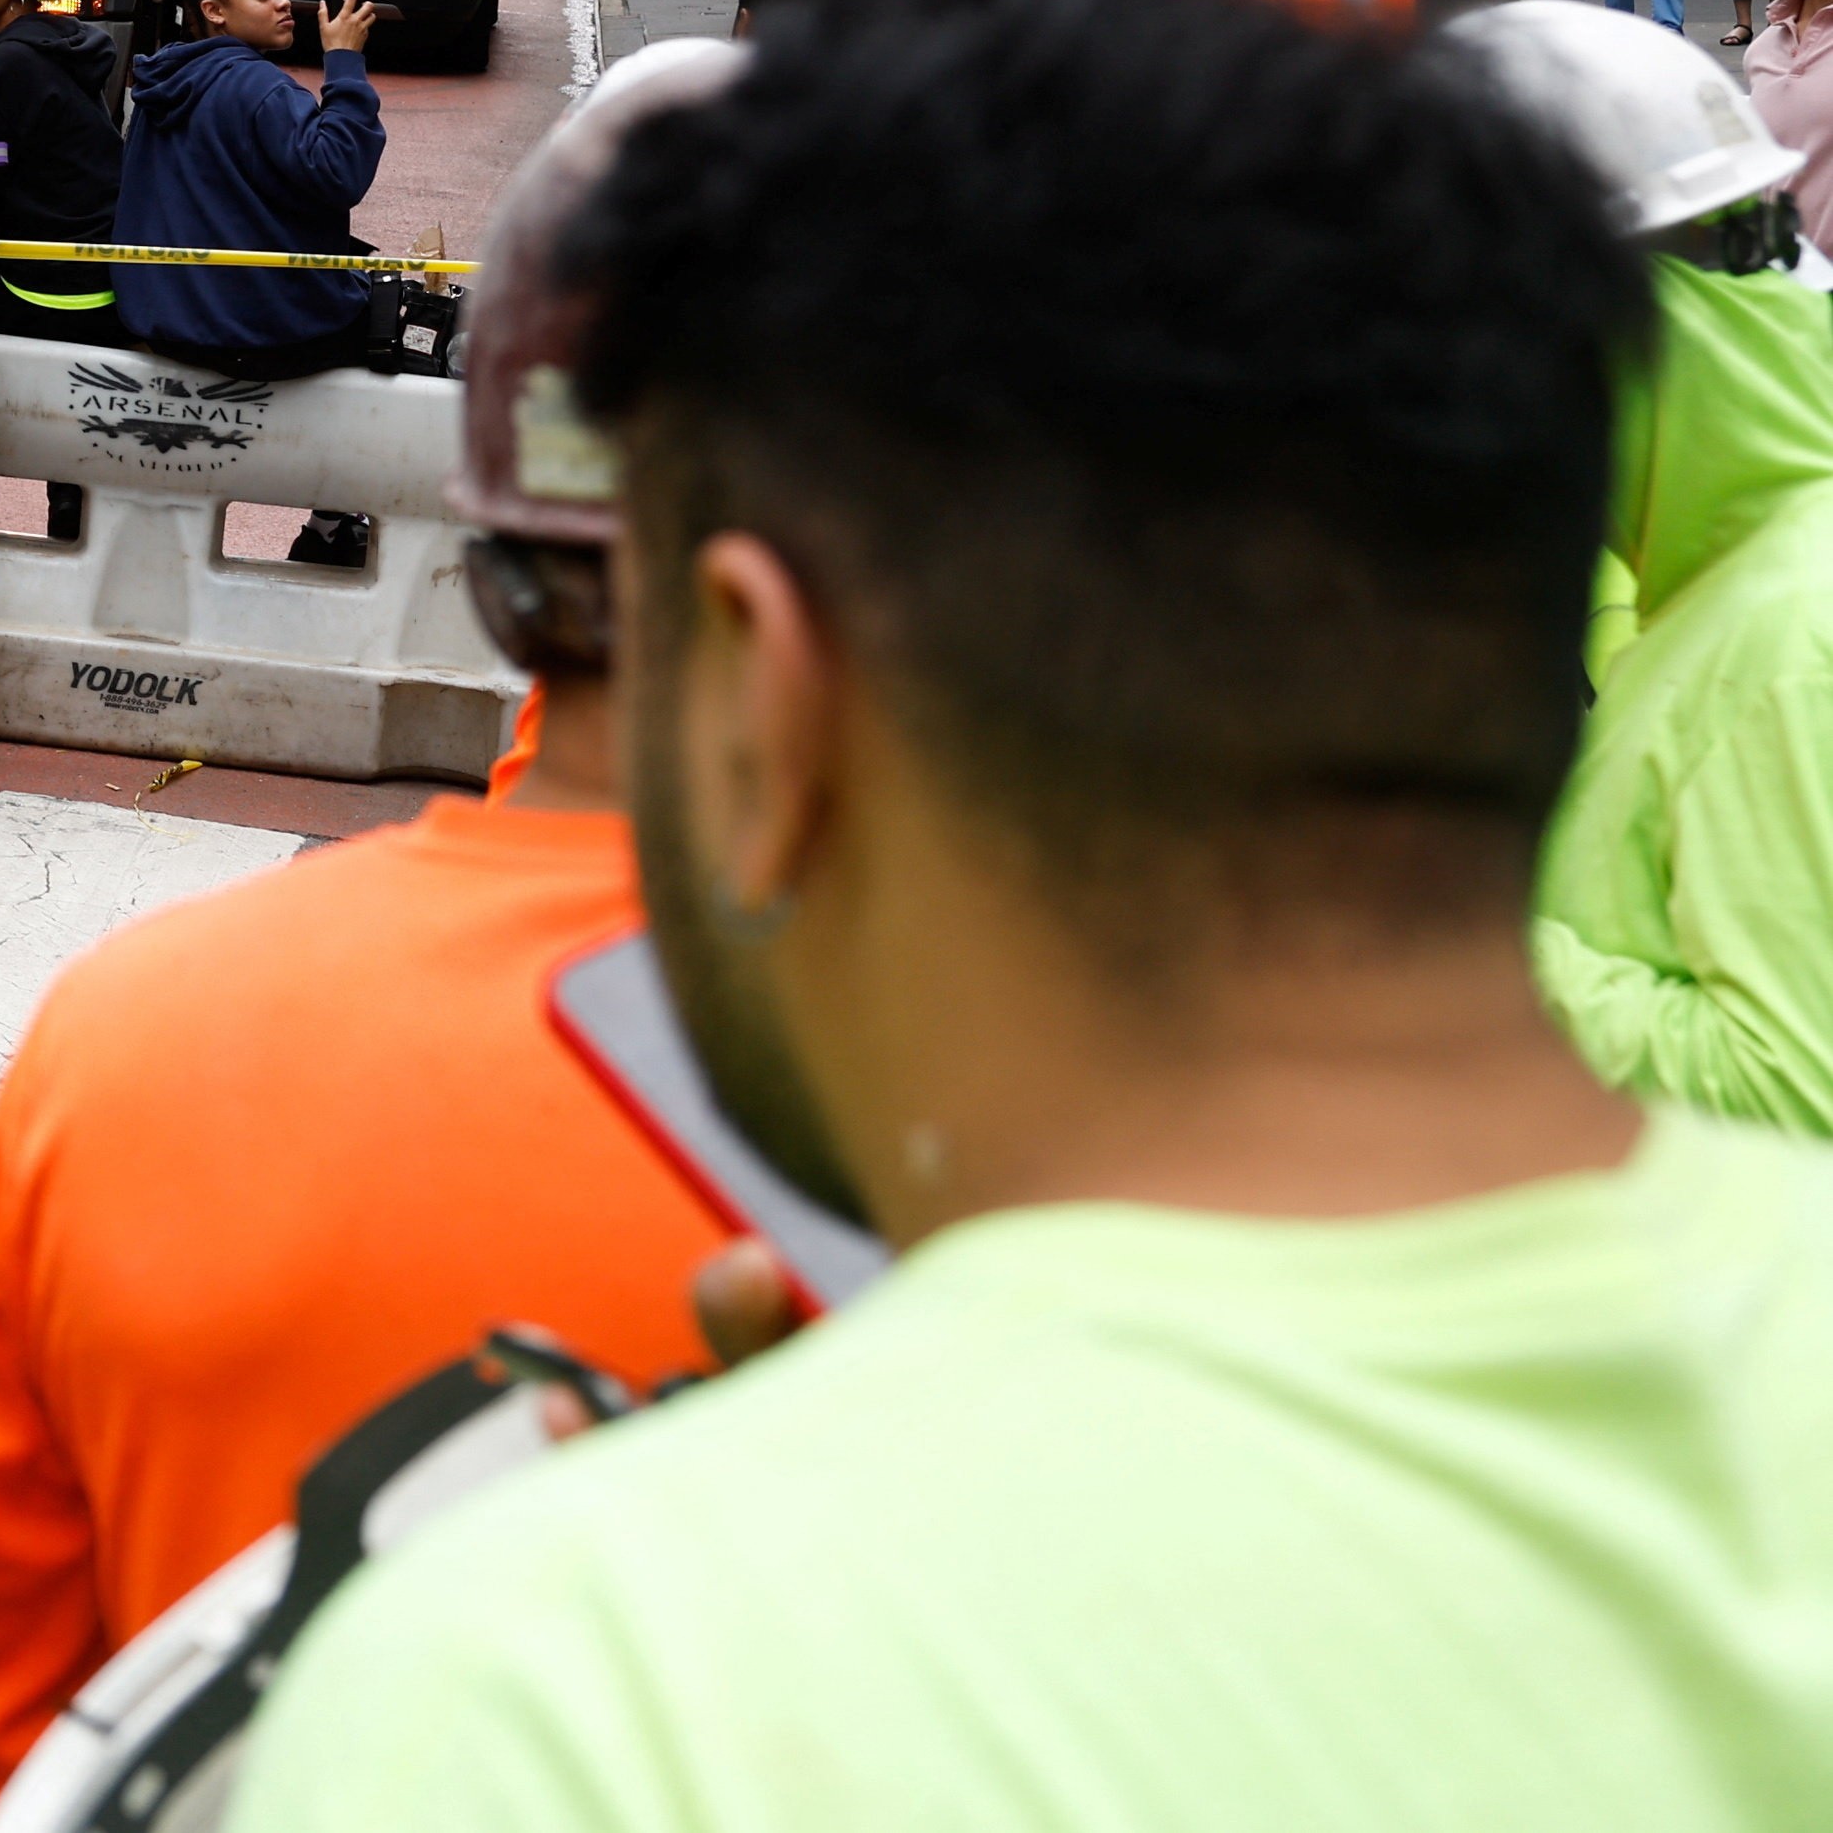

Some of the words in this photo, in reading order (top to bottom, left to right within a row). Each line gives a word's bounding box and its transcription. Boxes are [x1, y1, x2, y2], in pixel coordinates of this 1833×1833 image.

[82, 395, 253, 426] ARSENAL
[70, 661, 204, 706] YODOCK
[99, 693, 167, 709] 1-888-496-3625
